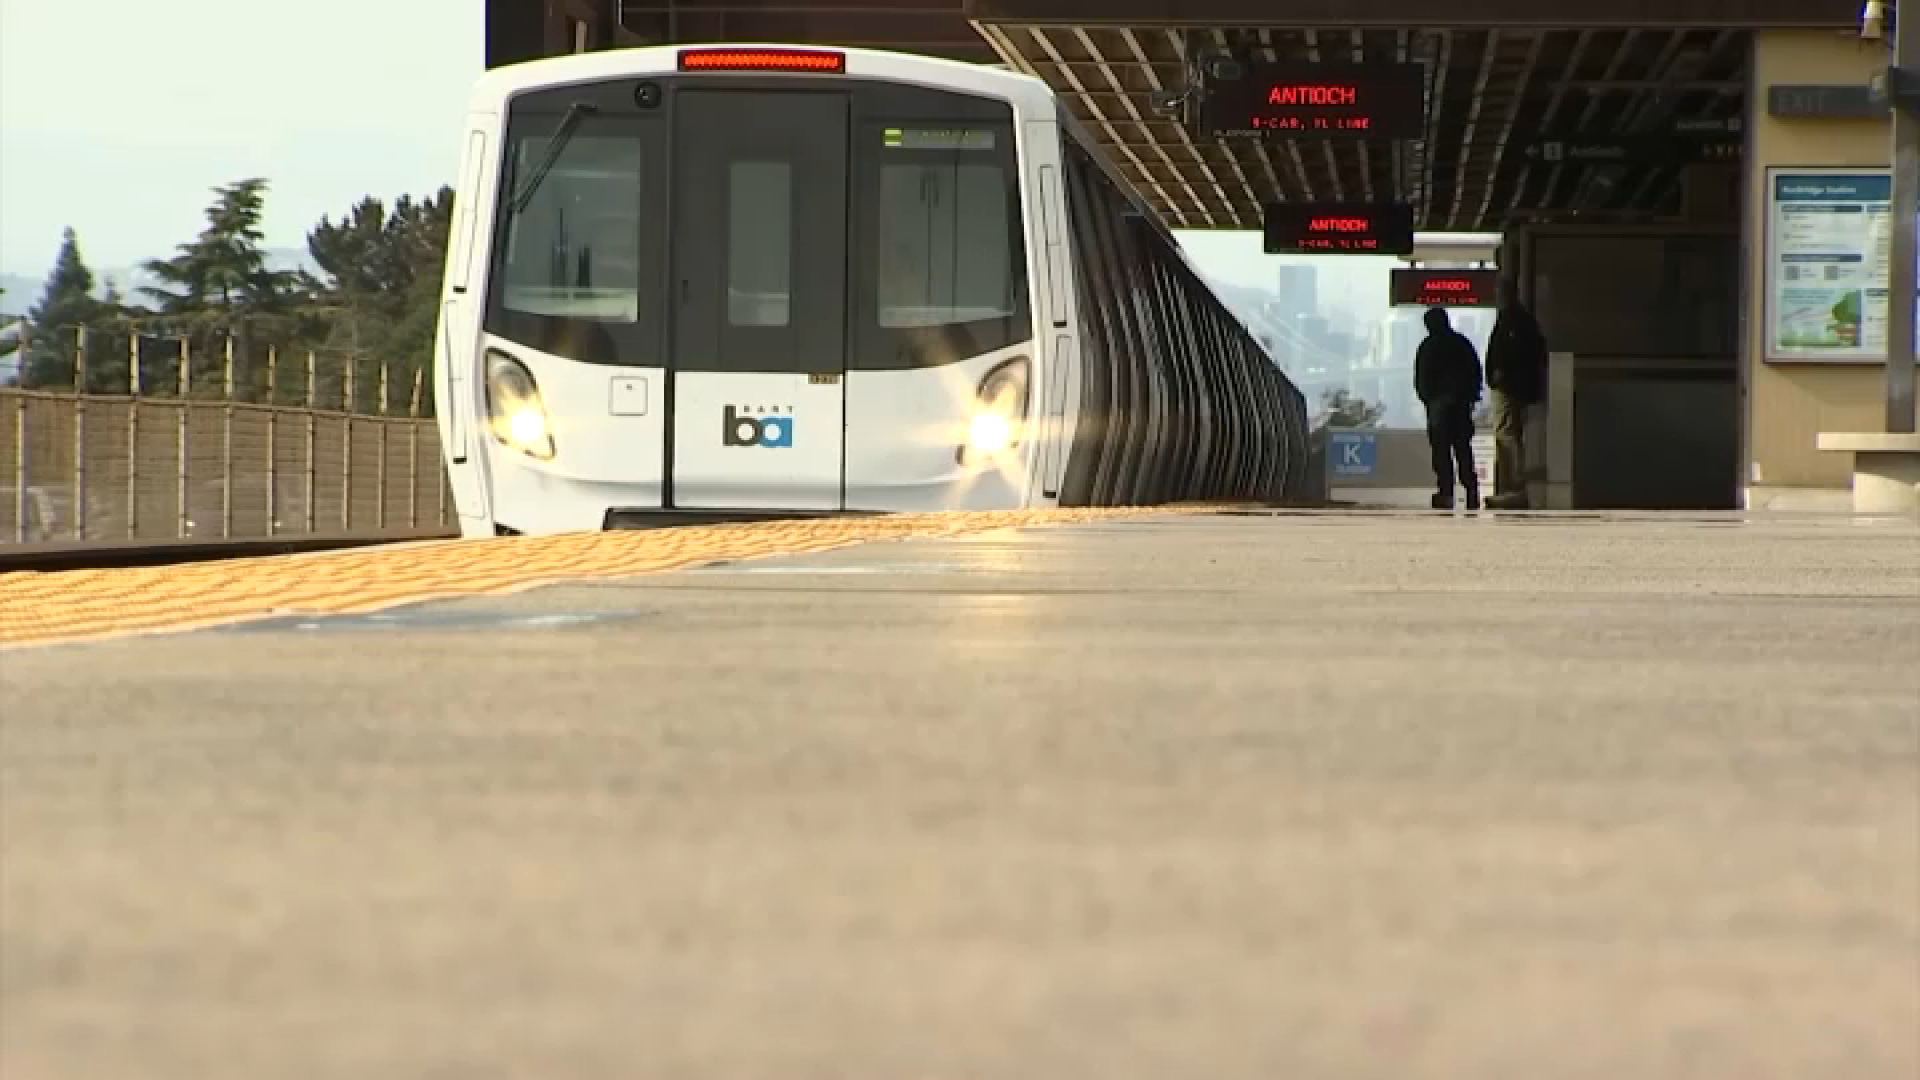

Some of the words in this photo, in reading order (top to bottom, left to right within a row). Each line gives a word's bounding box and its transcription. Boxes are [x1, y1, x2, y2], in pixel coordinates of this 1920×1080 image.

[1268, 86, 1356, 105] ANTIOCH
[1308, 218, 1369, 232] ANTIOCH
[1424, 280, 1470, 291] ANTIOCH
[743, 405, 793, 413] BART
[1343, 443, 1361, 465] K
